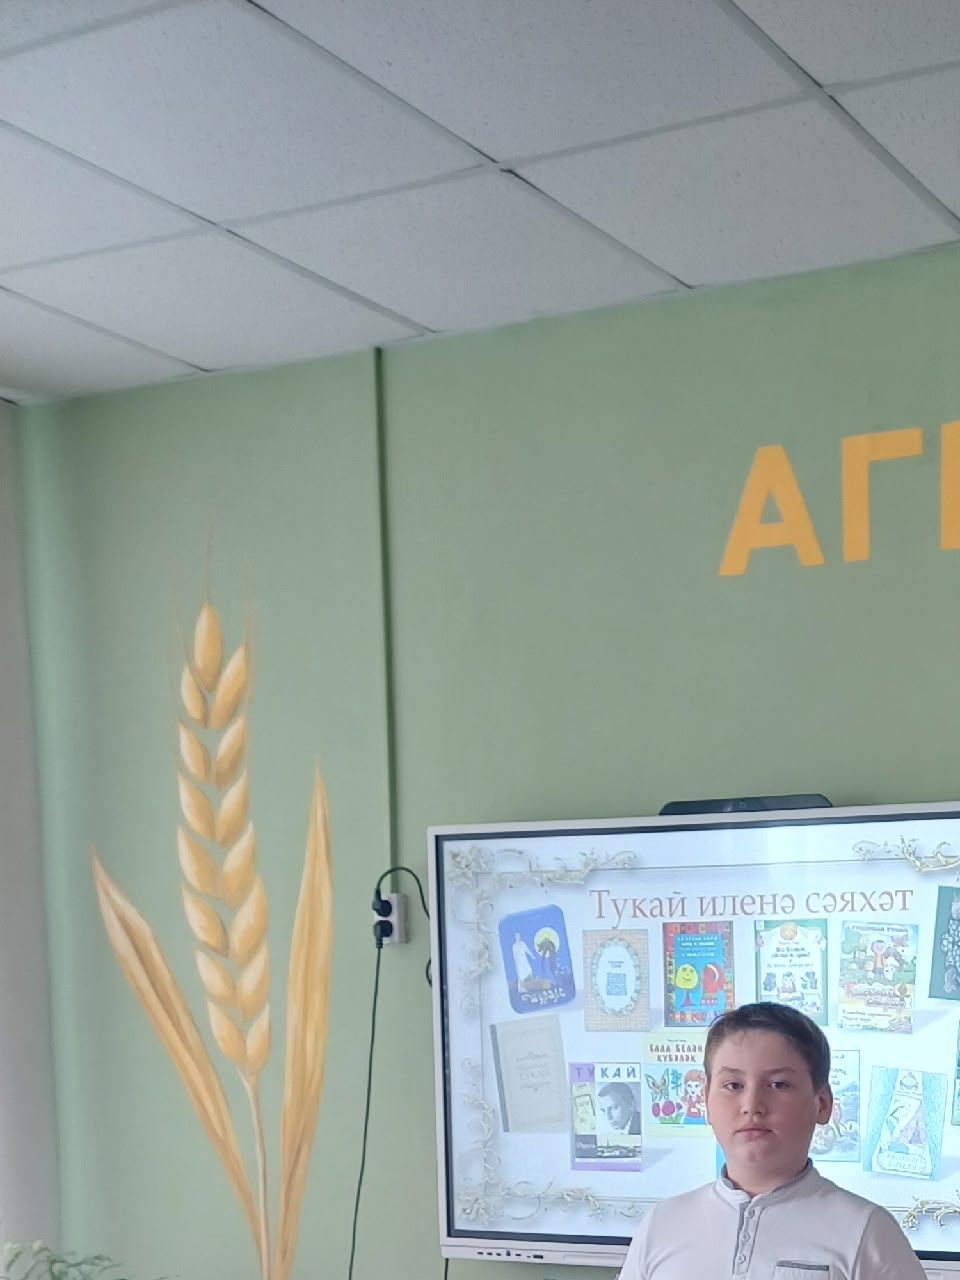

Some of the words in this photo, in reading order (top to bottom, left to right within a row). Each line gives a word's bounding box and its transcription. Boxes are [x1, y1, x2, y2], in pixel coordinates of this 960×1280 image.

[589, 889, 688, 929] Тукай
[699, 896, 795, 917] иленә
[805, 889, 914, 914] сәяхәт
[575, 1066, 636, 1079] ТУКАЙ
